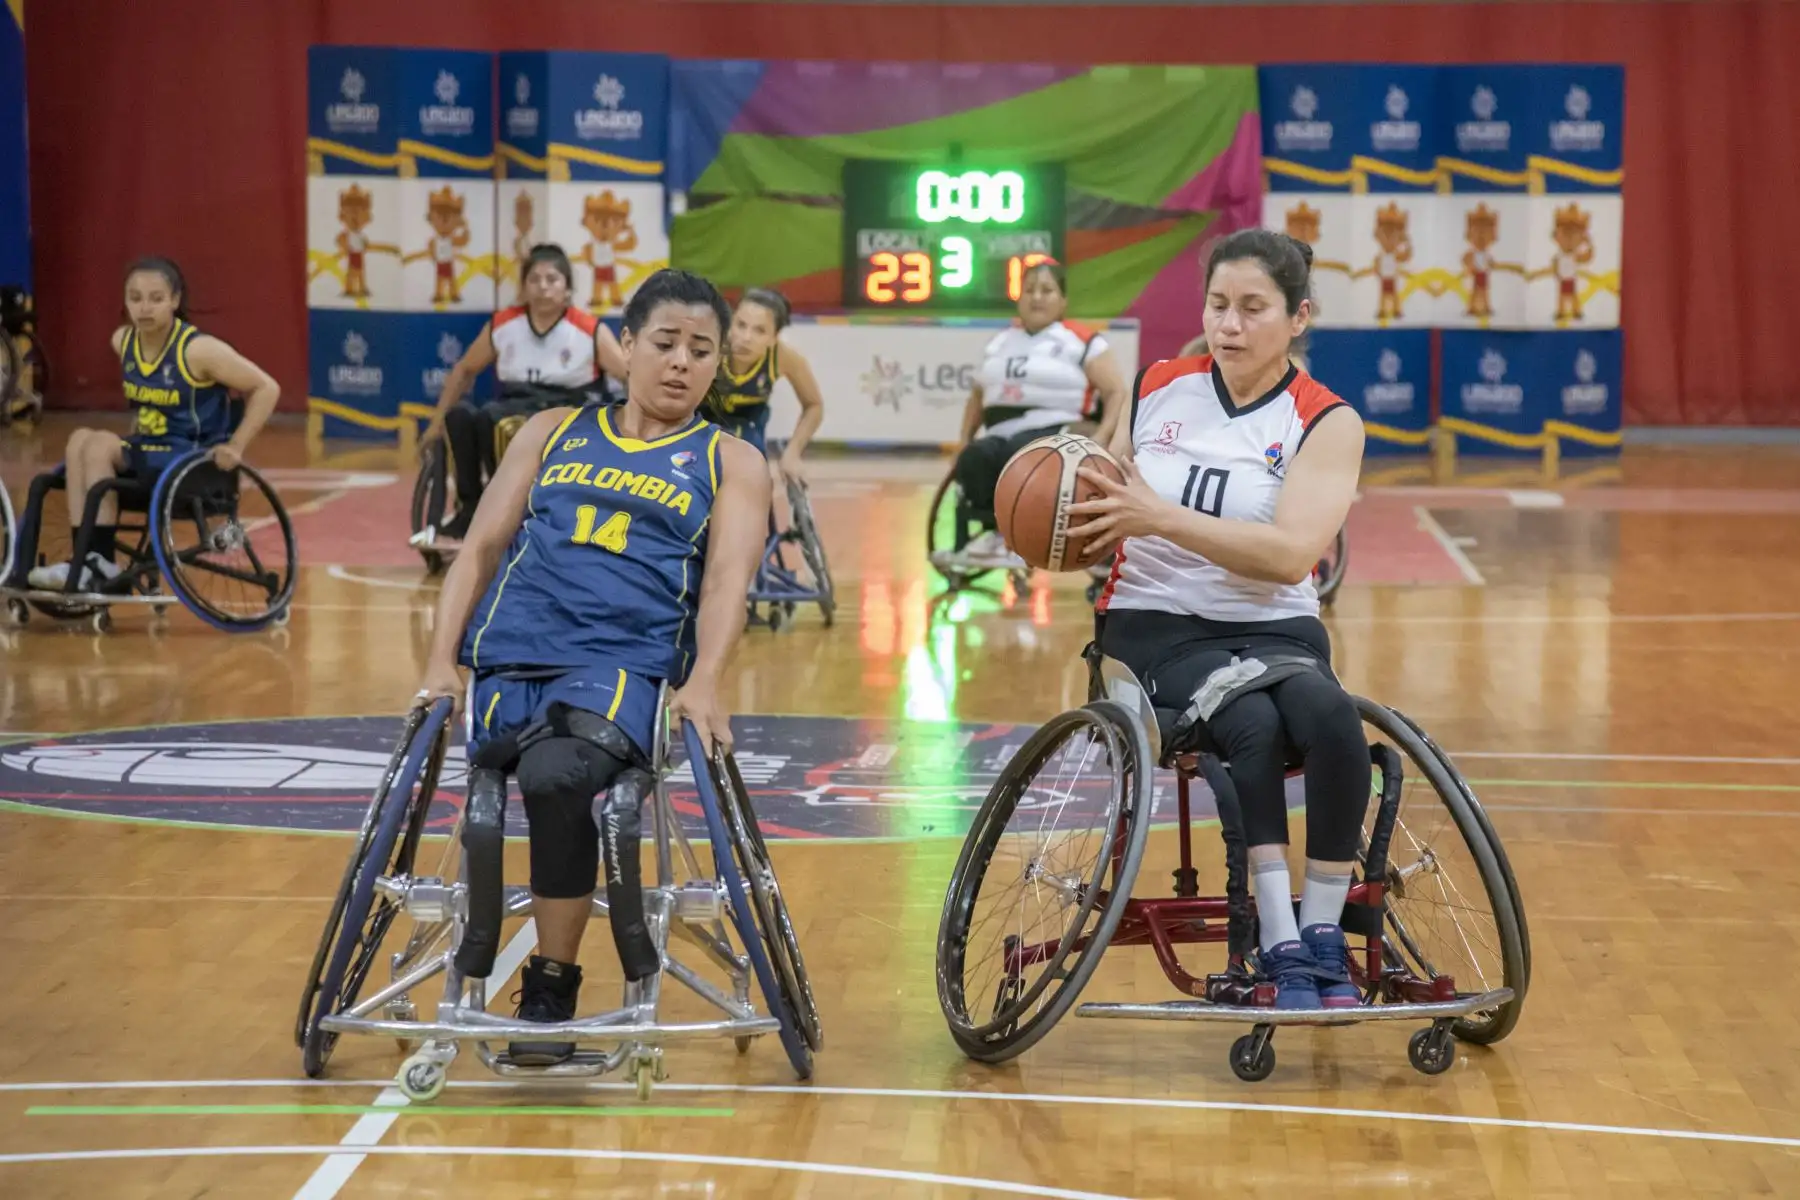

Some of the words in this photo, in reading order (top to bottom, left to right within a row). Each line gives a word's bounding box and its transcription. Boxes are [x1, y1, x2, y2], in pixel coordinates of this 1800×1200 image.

[916, 170, 1024, 222] 0:00
[866, 252, 931, 302] 23
[940, 236, 973, 287] 3
[1007, 254, 1050, 301] 1
[1005, 356, 1029, 379] 12
[540, 461, 693, 517] COLOMBIA
[1181, 464, 1230, 518] 10
[571, 504, 632, 554] 14
